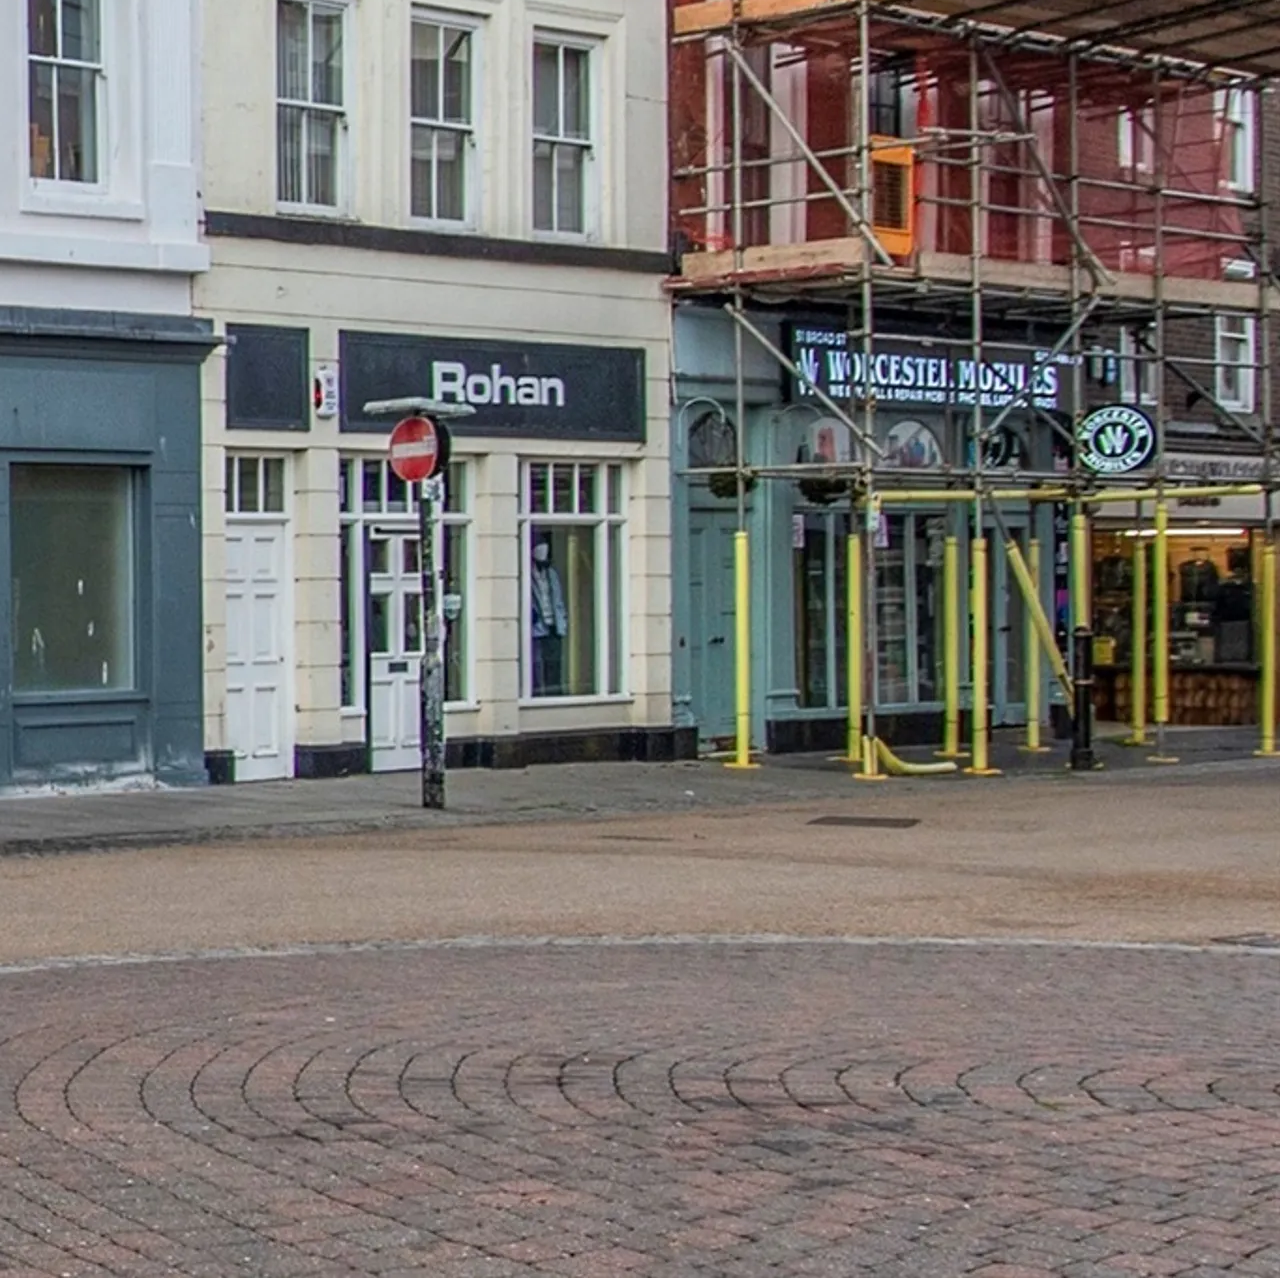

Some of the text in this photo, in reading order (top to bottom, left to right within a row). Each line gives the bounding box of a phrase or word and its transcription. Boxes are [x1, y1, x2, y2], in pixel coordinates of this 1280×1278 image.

[805, 330, 835, 345] BROAD
[432, 360, 565, 407] Rohan
[925, 391, 956, 404] MOBIE
